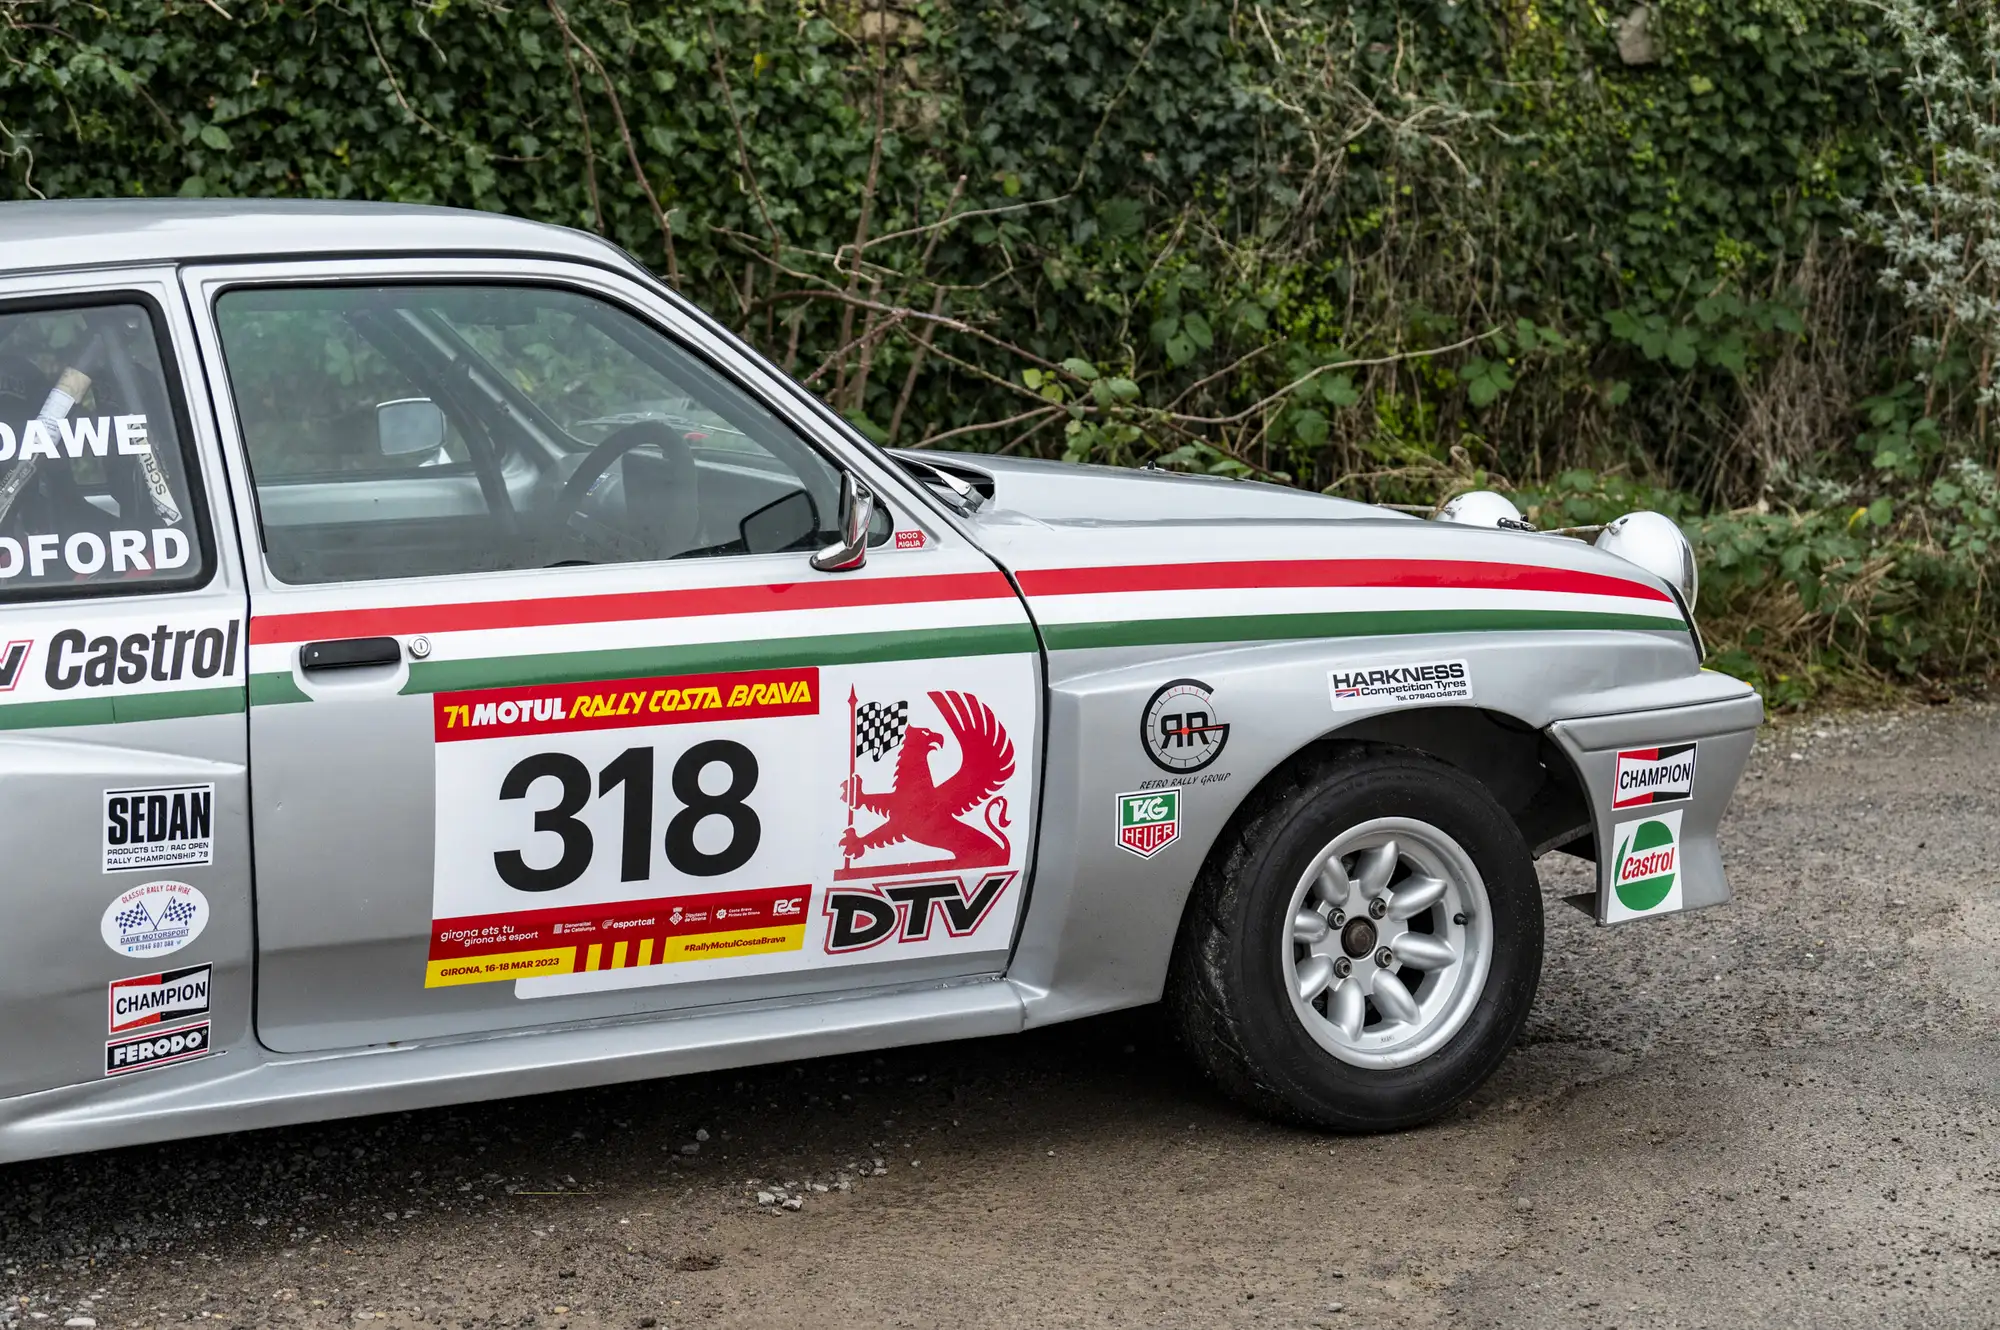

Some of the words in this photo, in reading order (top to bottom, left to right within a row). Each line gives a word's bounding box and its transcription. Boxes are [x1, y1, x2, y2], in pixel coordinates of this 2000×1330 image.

[898, 532, 918, 540] 1000
[45, 619, 240, 690] Castrol
[1333, 663, 1465, 688] HARKNESS
[1361, 682, 1433, 696] Competition
[1435, 680, 1467, 690] Tyres
[1409, 692, 1436, 700] 07840
[444, 705, 470, 728] 71
[472, 698, 566, 727] MOTUL
[569, 691, 647, 719] RALLY
[649, 687, 722, 713] COSTA
[727, 681, 811, 707] BRAVA
[1140, 780, 1168, 790] RETRO
[1171, 776, 1199, 787] RALLY
[1200, 773, 1231, 785] GROUP
[1620, 763, 1691, 789] CHAMPION
[108, 791, 211, 845] SEDAN
[493, 739, 761, 892] 318
[1130, 796, 1168, 822] TAG
[1125, 825, 1172, 849] HEUER
[107, 847, 149, 855] PRODUCTS
[151, 845, 164, 853] LTD
[188, 842, 209, 850] OPEN
[107, 856, 132, 865] RALLY
[135, 852, 196, 863] CHAMPIONSHIP
[1621, 847, 1675, 880] Castrol
[121, 888, 145, 904] CLASSIC
[146, 885, 164, 895] RALLY
[165, 884, 177, 892] CAR
[178, 885, 191, 895] HIRE
[825, 872, 1015, 953] DTV
[613, 917, 655, 930] esportcat
[120, 935, 141, 945] DAWE
[142, 929, 190, 940] MOTORSPORT
[440, 928, 478, 943] girona
[482, 926, 499, 936] ets
[502, 925, 514, 934] tu
[464, 936, 494, 947] girona
[509, 931, 538, 941] esport
[684, 935, 785, 952] #RallyMotulCostaBrava
[440, 966, 482, 977] GIRONA,
[485, 962, 509, 973] 16-18
[511, 960, 533, 969] MAR
[535, 957, 559, 967] 2023
[116, 981, 206, 1015] CHAMPION
[113, 1031, 202, 1066] FERODO
